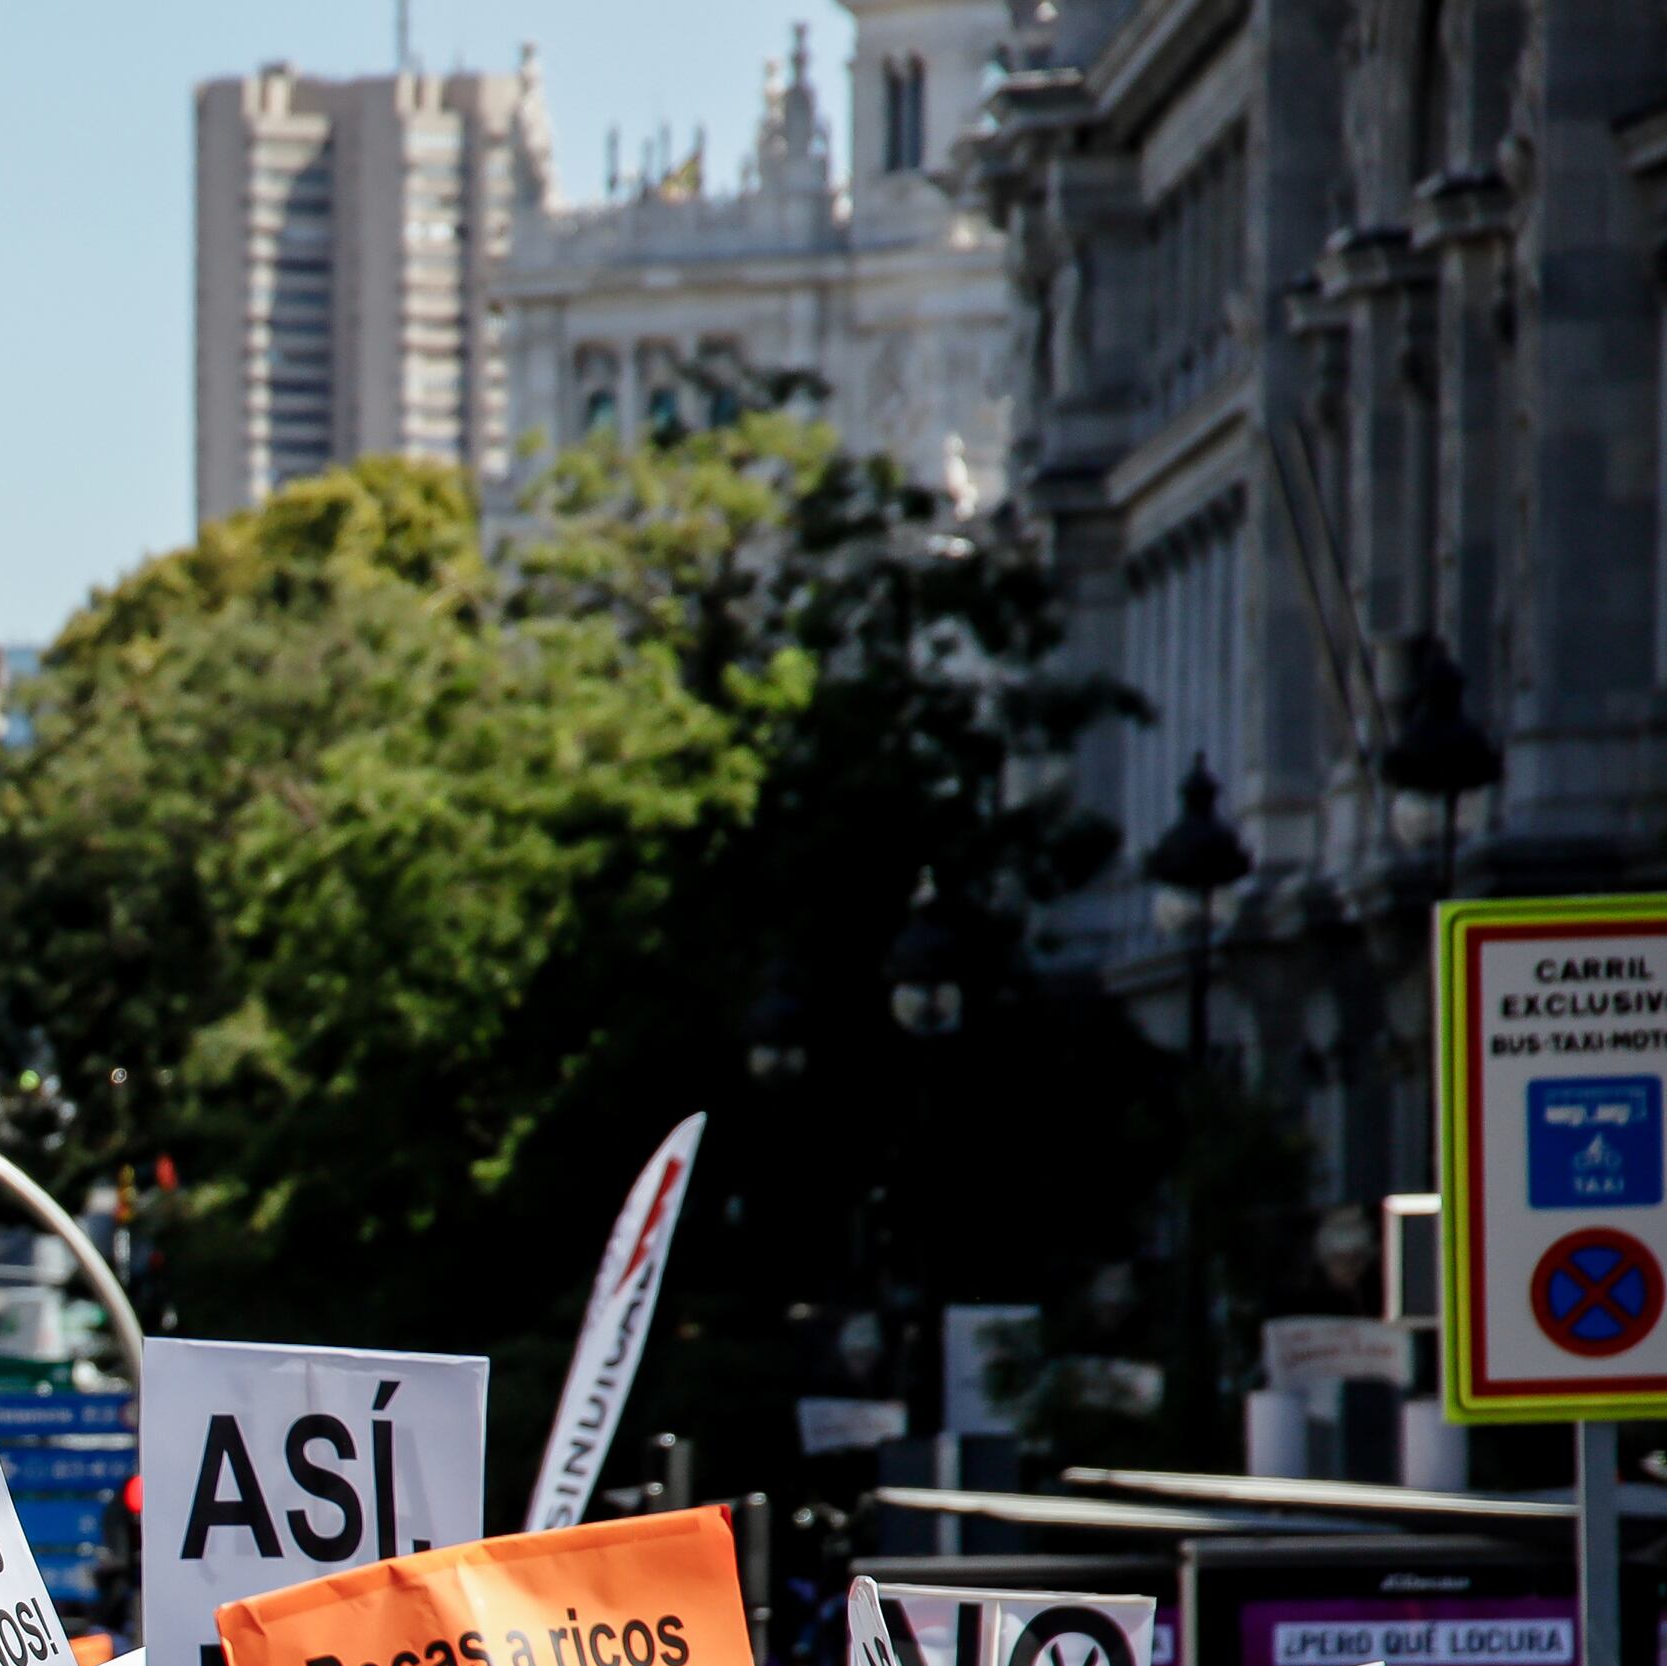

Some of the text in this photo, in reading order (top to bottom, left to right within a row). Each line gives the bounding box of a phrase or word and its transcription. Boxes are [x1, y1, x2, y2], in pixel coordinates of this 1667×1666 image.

[1536, 956, 1653, 984] CARRIL
[1501, 990, 1667, 1019] EXCLUSIV
[1384, 1621, 1437, 1654] QUÉ
[1448, 1628, 1564, 1654] LOCURA
